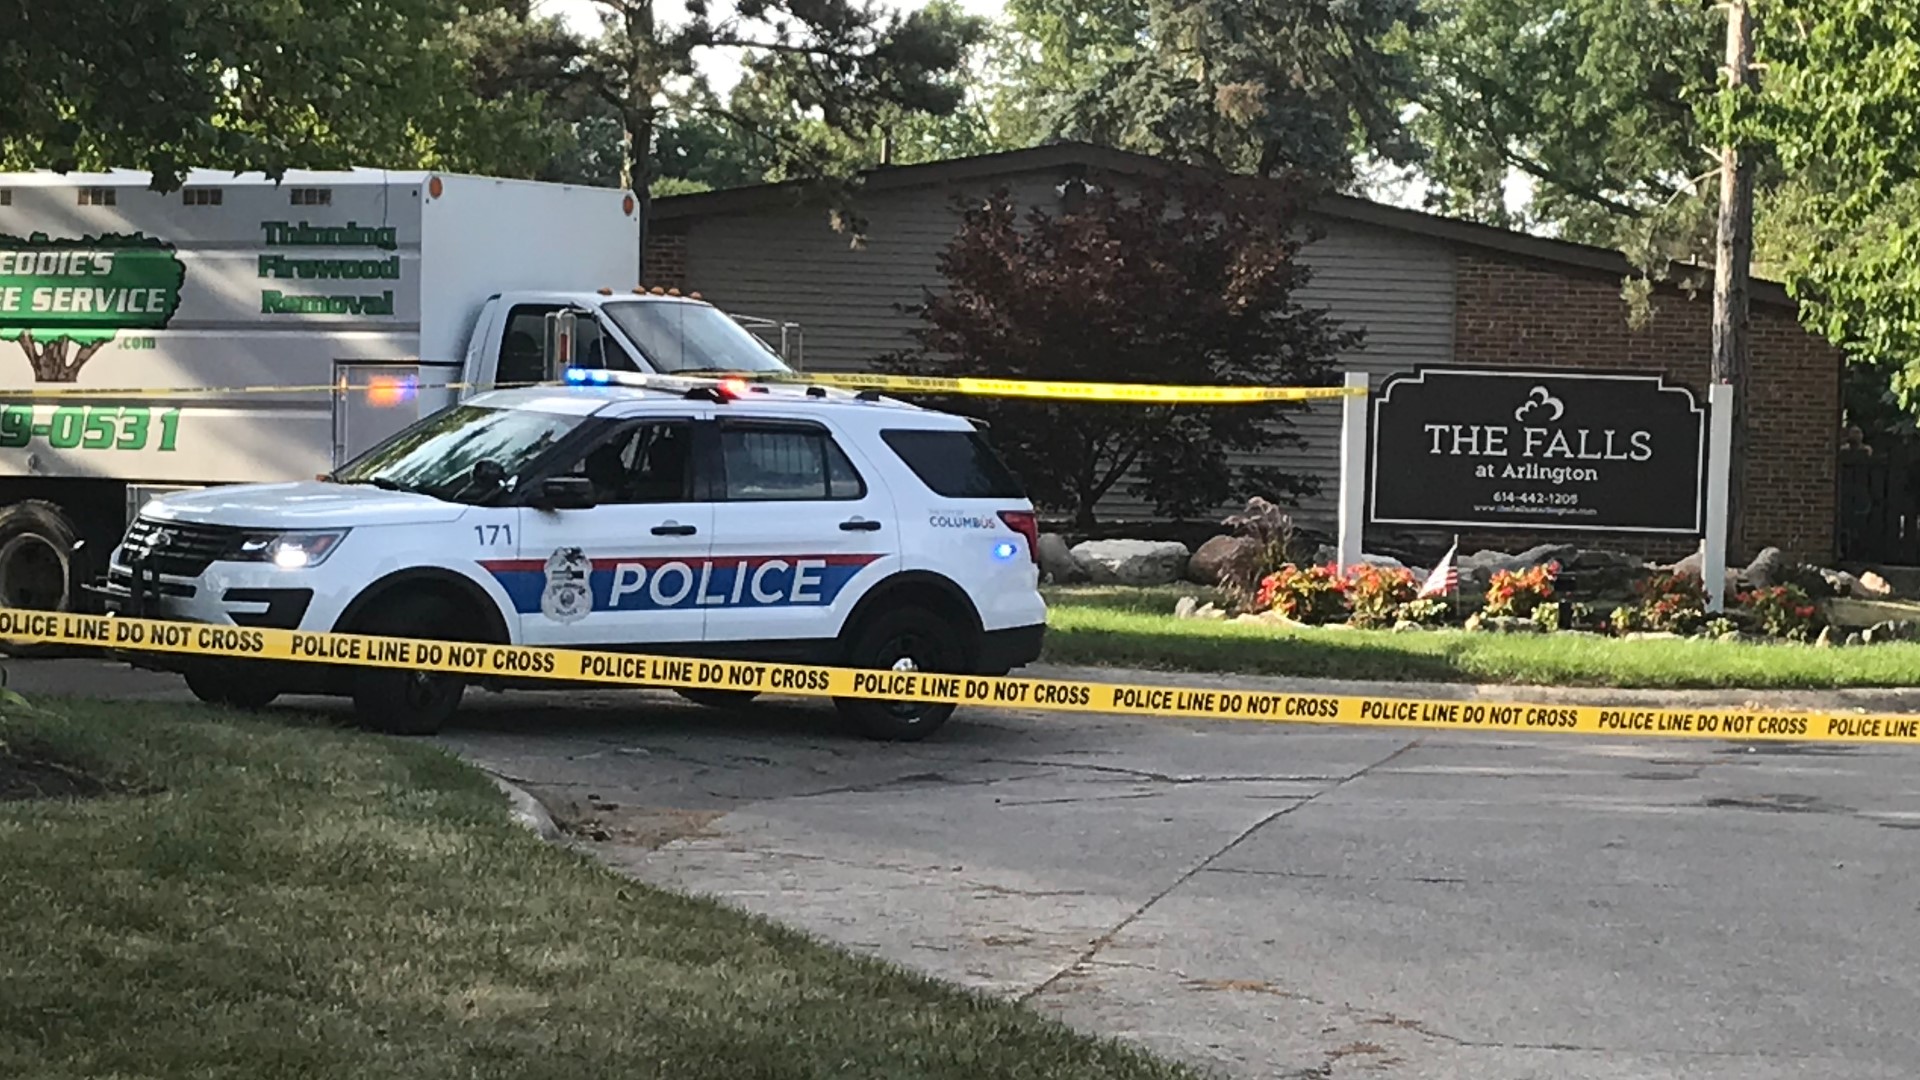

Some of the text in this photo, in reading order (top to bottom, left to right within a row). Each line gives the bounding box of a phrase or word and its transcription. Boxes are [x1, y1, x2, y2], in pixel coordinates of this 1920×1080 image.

[261, 221, 398, 251] Thinning
[0, 251, 115, 275] EDDIE'S
[258, 254, 400, 279] Firewood
[0, 287, 166, 313] E SERVICE
[261, 290, 394, 315] Removal
[118, 336, 156, 349] .com
[1424, 424, 1653, 461] THE FALLS
[1475, 463, 1598, 485] at Arlington
[474, 524, 513, 545] 171
[929, 515, 996, 529] COLUMBUS
[608, 559, 827, 607] POLICE
[63, 619, 110, 641] LINE
[115, 623, 145, 644] DO
[149, 626, 192, 647] NOT
[198, 630, 264, 653] CROSS
[290, 636, 555, 673] POLICE LINE DO NOT CROSS
[579, 656, 830, 691] POLICE LINE DO NOT CROSS
[853, 673, 1091, 706] POLICE LINE DO NOT CROSS
[1112, 688, 1339, 718] POLICE LINE DO NOT CROSS
[1360, 700, 1579, 728] POLICE LINE DO NOT CROSS
[1598, 711, 1809, 735] POLICE LINE DO NOT CROSS
[1827, 718, 1919, 738] POLICE LINE
